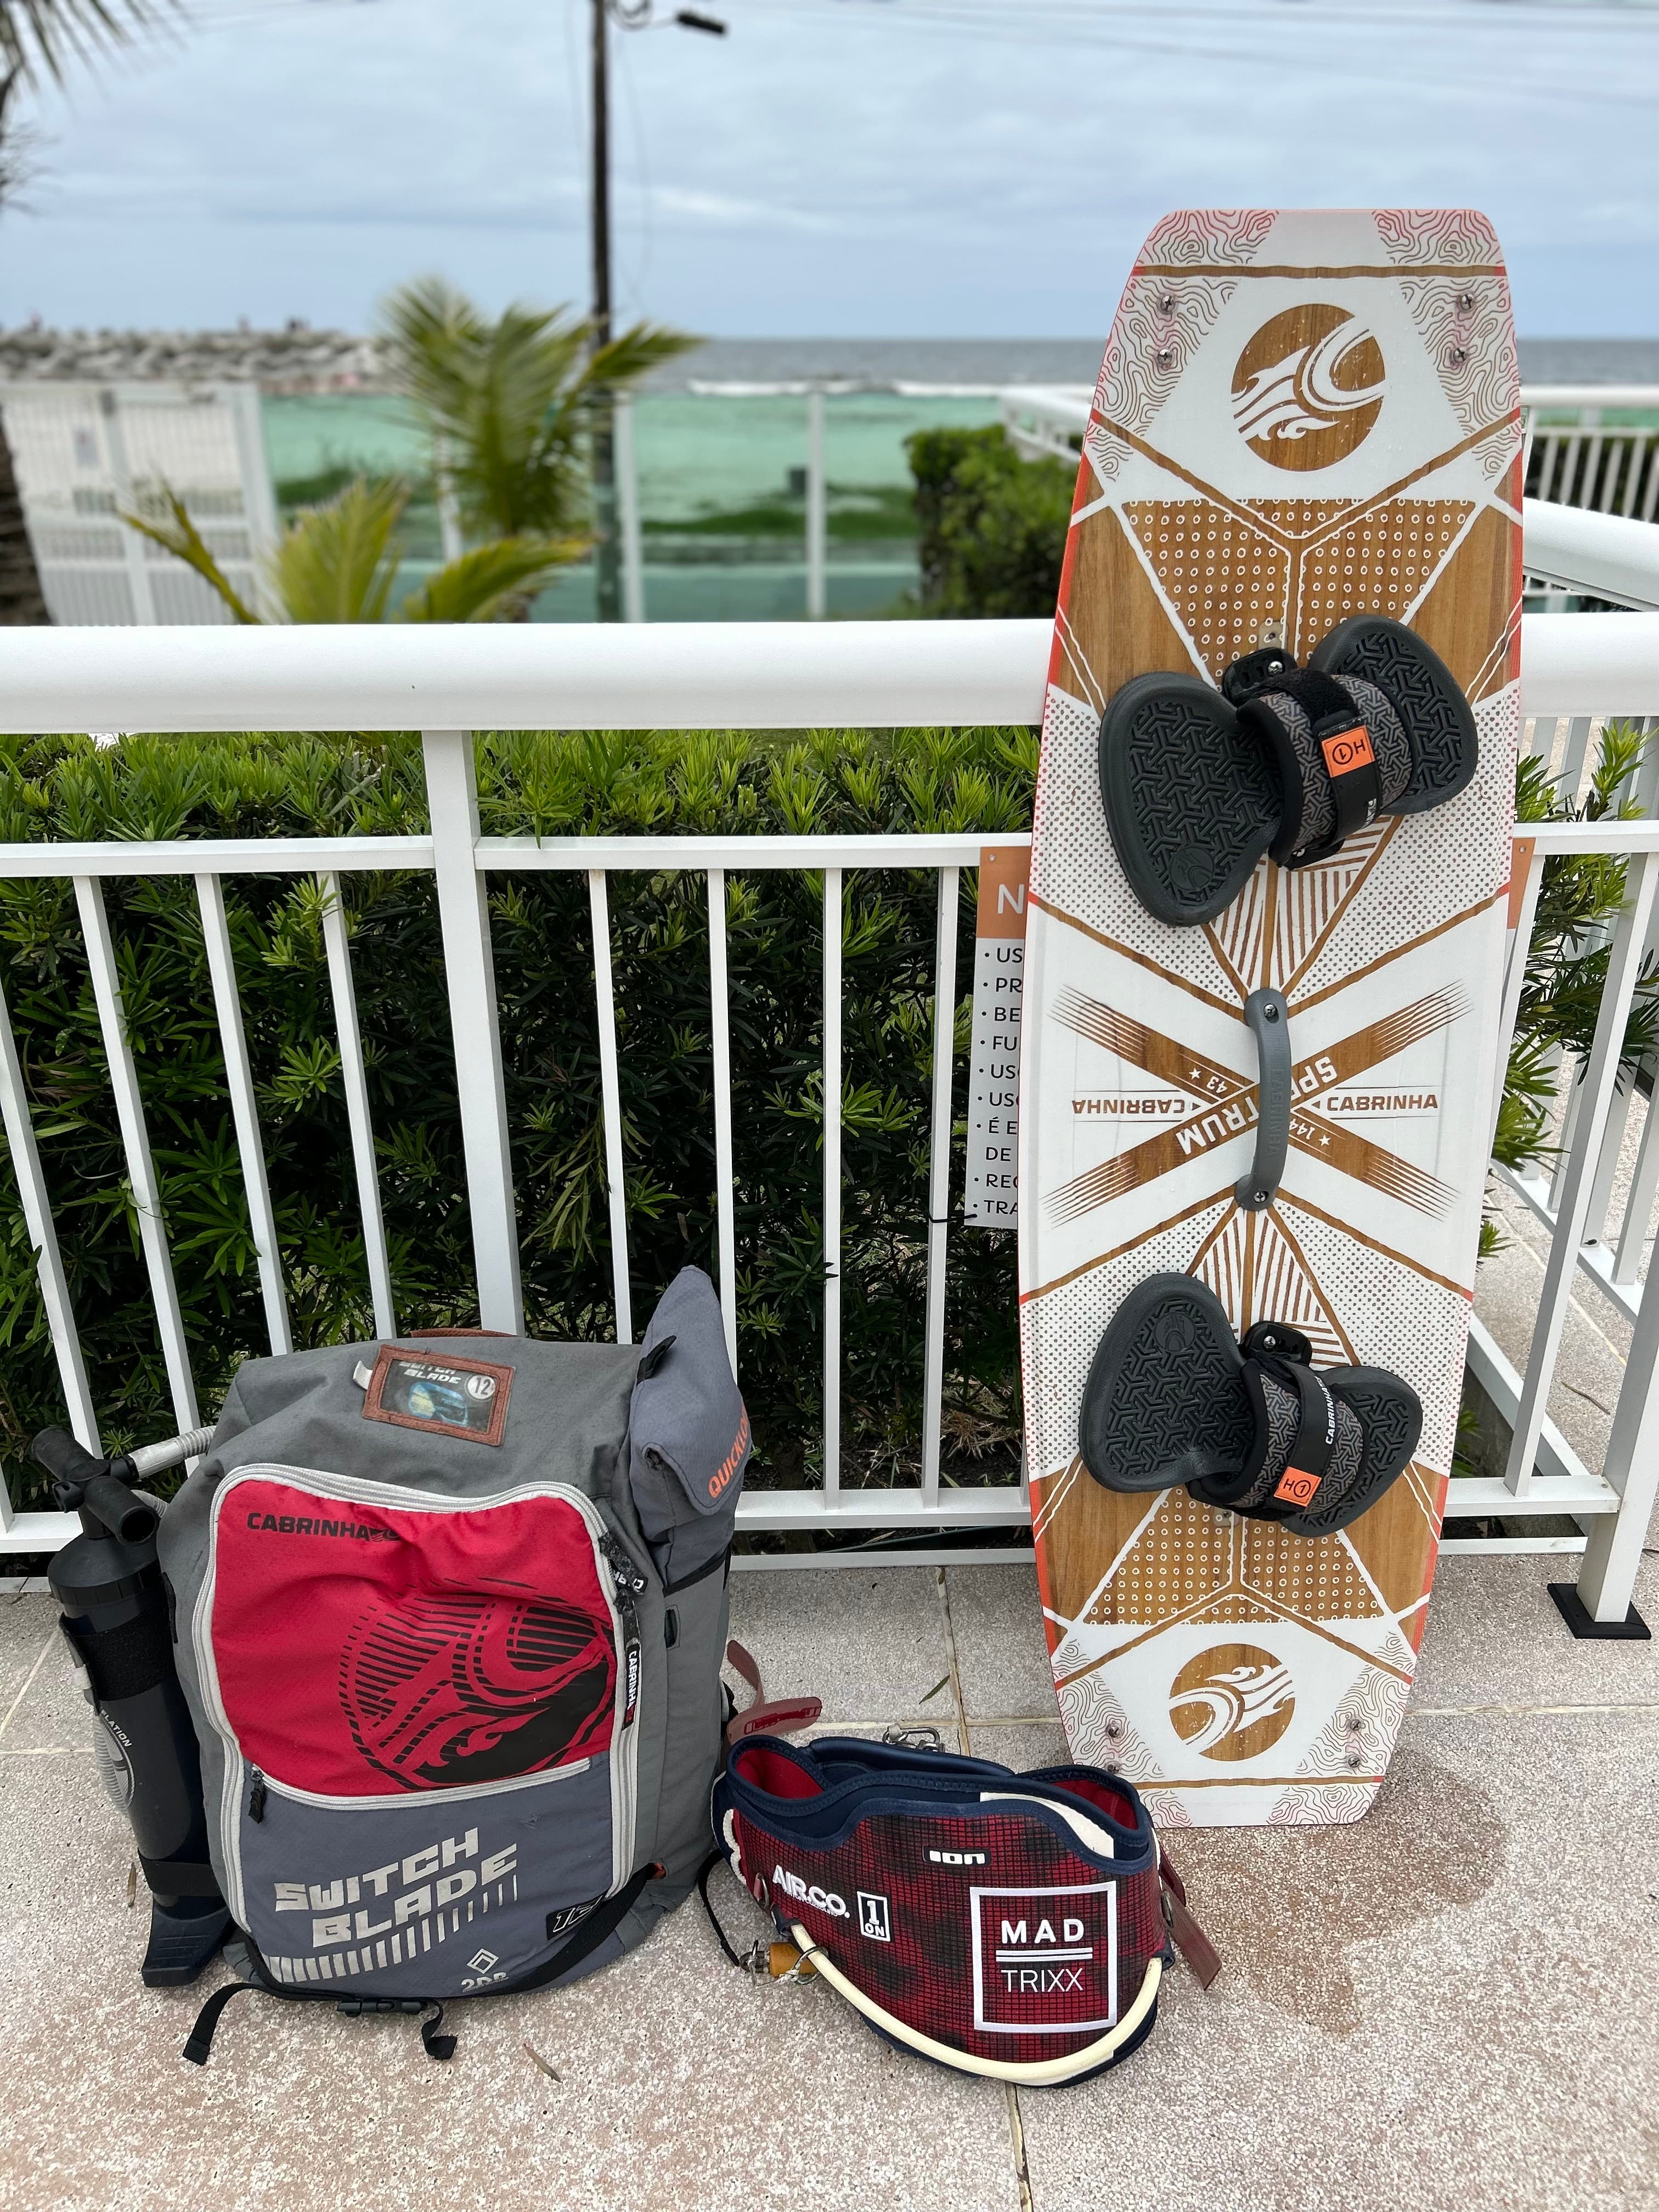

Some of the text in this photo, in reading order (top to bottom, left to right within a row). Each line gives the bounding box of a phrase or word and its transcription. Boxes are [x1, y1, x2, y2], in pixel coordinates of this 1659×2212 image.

[990, 1063, 1020, 1080] US
[1206, 1075, 1228, 1094] 43
[1071, 1099, 1185, 1114] CABRINHA
[1175, 1056, 1338, 1155] SPETRUM
[1327, 1094, 1438, 1111] CABRINHA
[988, 1116, 1000, 1134] É
[1289, 1118, 1316, 1140] 144
[985, 1146, 1012, 1162] DE
[404, 1368, 462, 1384] BLADE
[474, 1377, 492, 1396] 12
[1322, 1386, 1337, 1445] CABRINHA
[247, 1512, 371, 1542] CABRINHA
[274, 1826, 479, 1912] SWITCH
[312, 1843, 518, 1948] BLADE
[864, 1922, 885, 1937] ON
[1001, 1918, 1085, 1944] MAD
[1000, 1967, 1084, 1993] TRIXX
